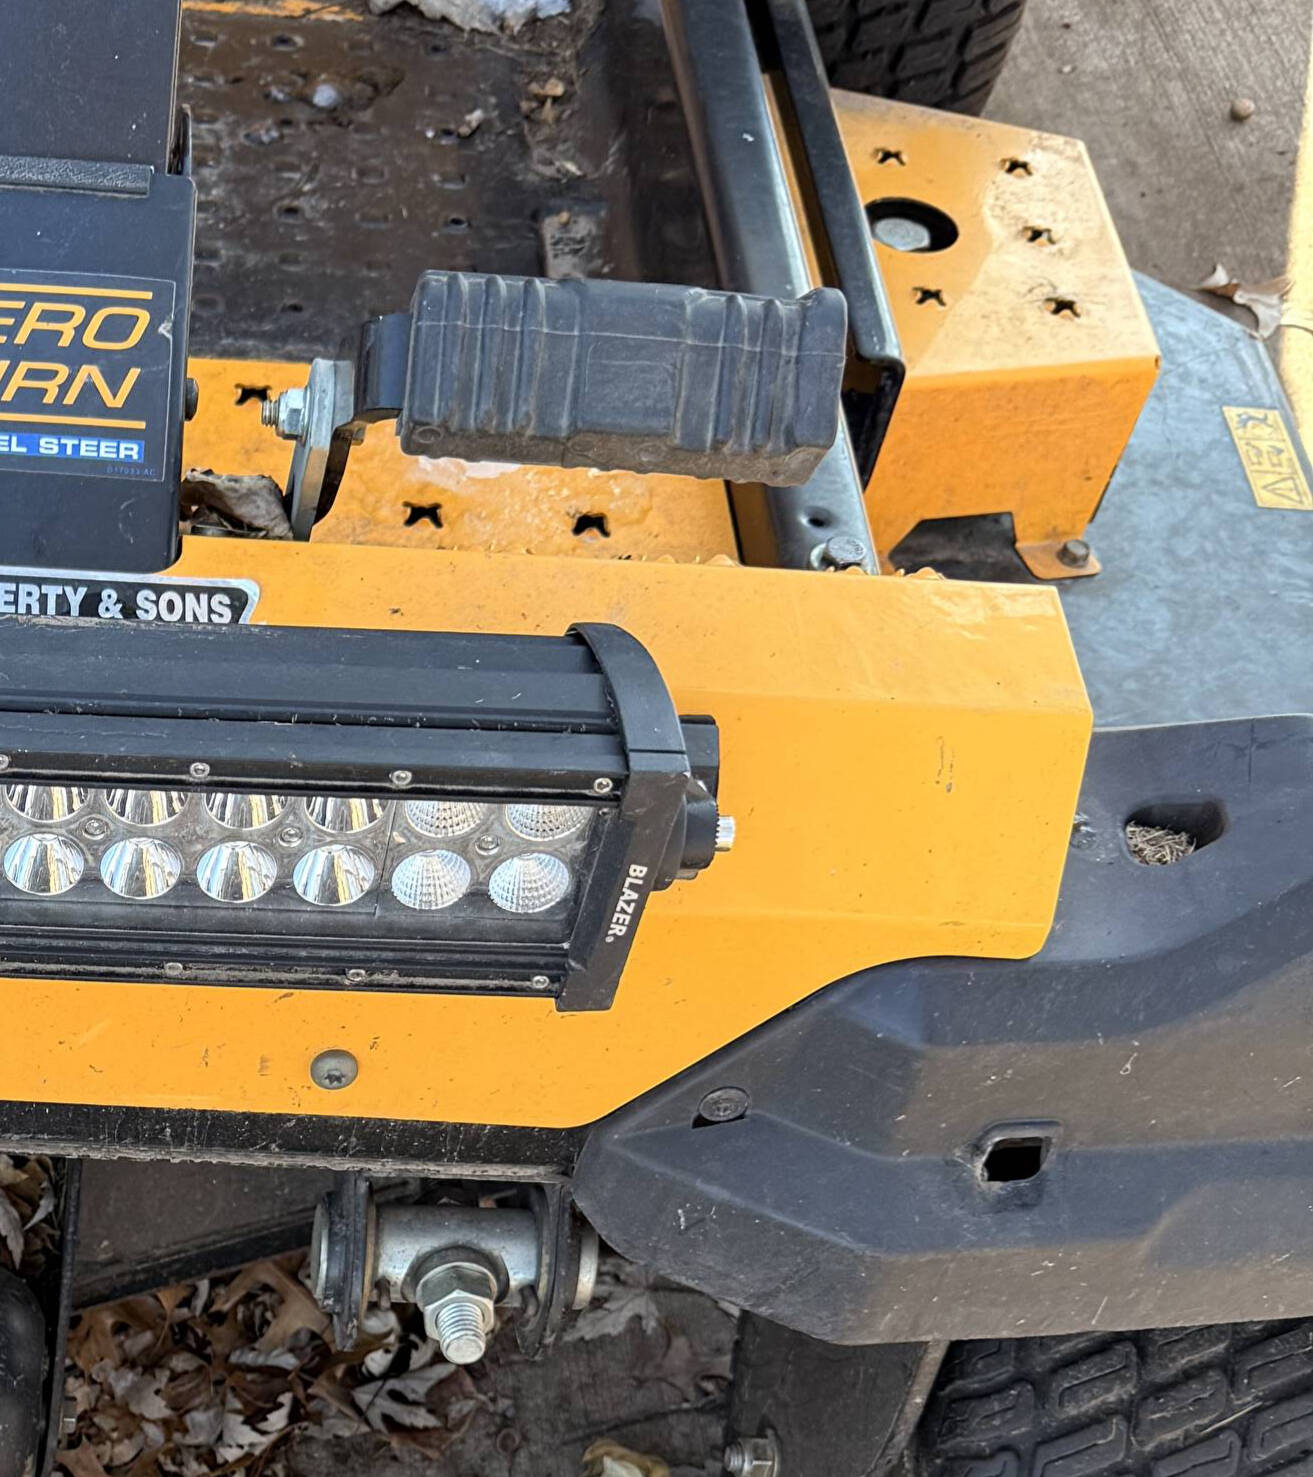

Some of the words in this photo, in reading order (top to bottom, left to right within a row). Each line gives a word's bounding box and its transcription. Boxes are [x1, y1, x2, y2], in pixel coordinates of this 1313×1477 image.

[38, 437, 140, 460] STEER
[97, 588, 124, 619] &
[135, 588, 233, 625] SONS
